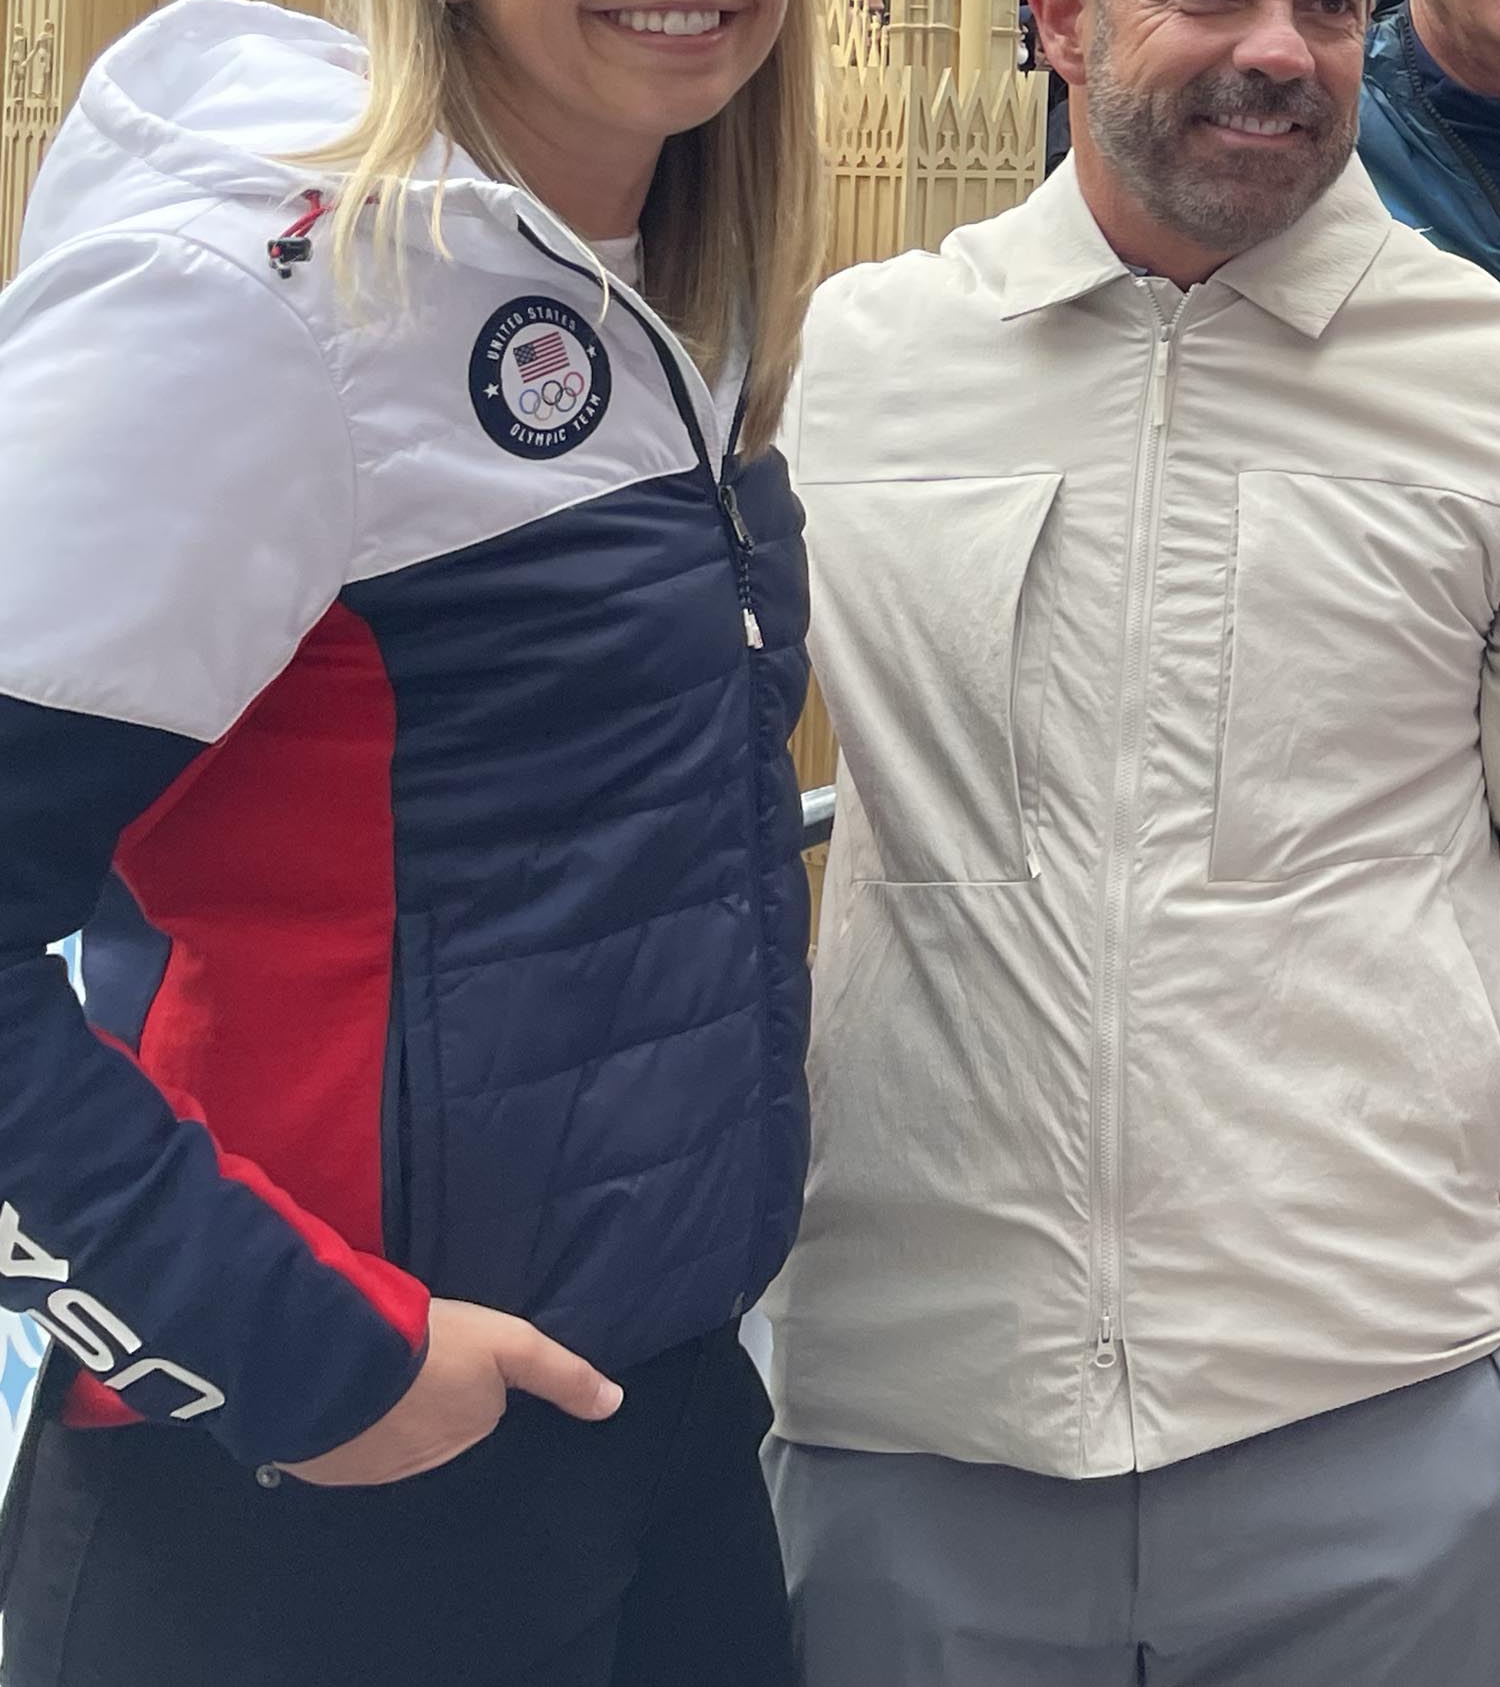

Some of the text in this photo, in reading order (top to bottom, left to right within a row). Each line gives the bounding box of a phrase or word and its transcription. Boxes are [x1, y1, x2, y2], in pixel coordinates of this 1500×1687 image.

[486, 306, 577, 361] UNITED STATES
[509, 393, 602, 447] OLYMPIC TEAM
[0, 1200, 226, 1420] USA
